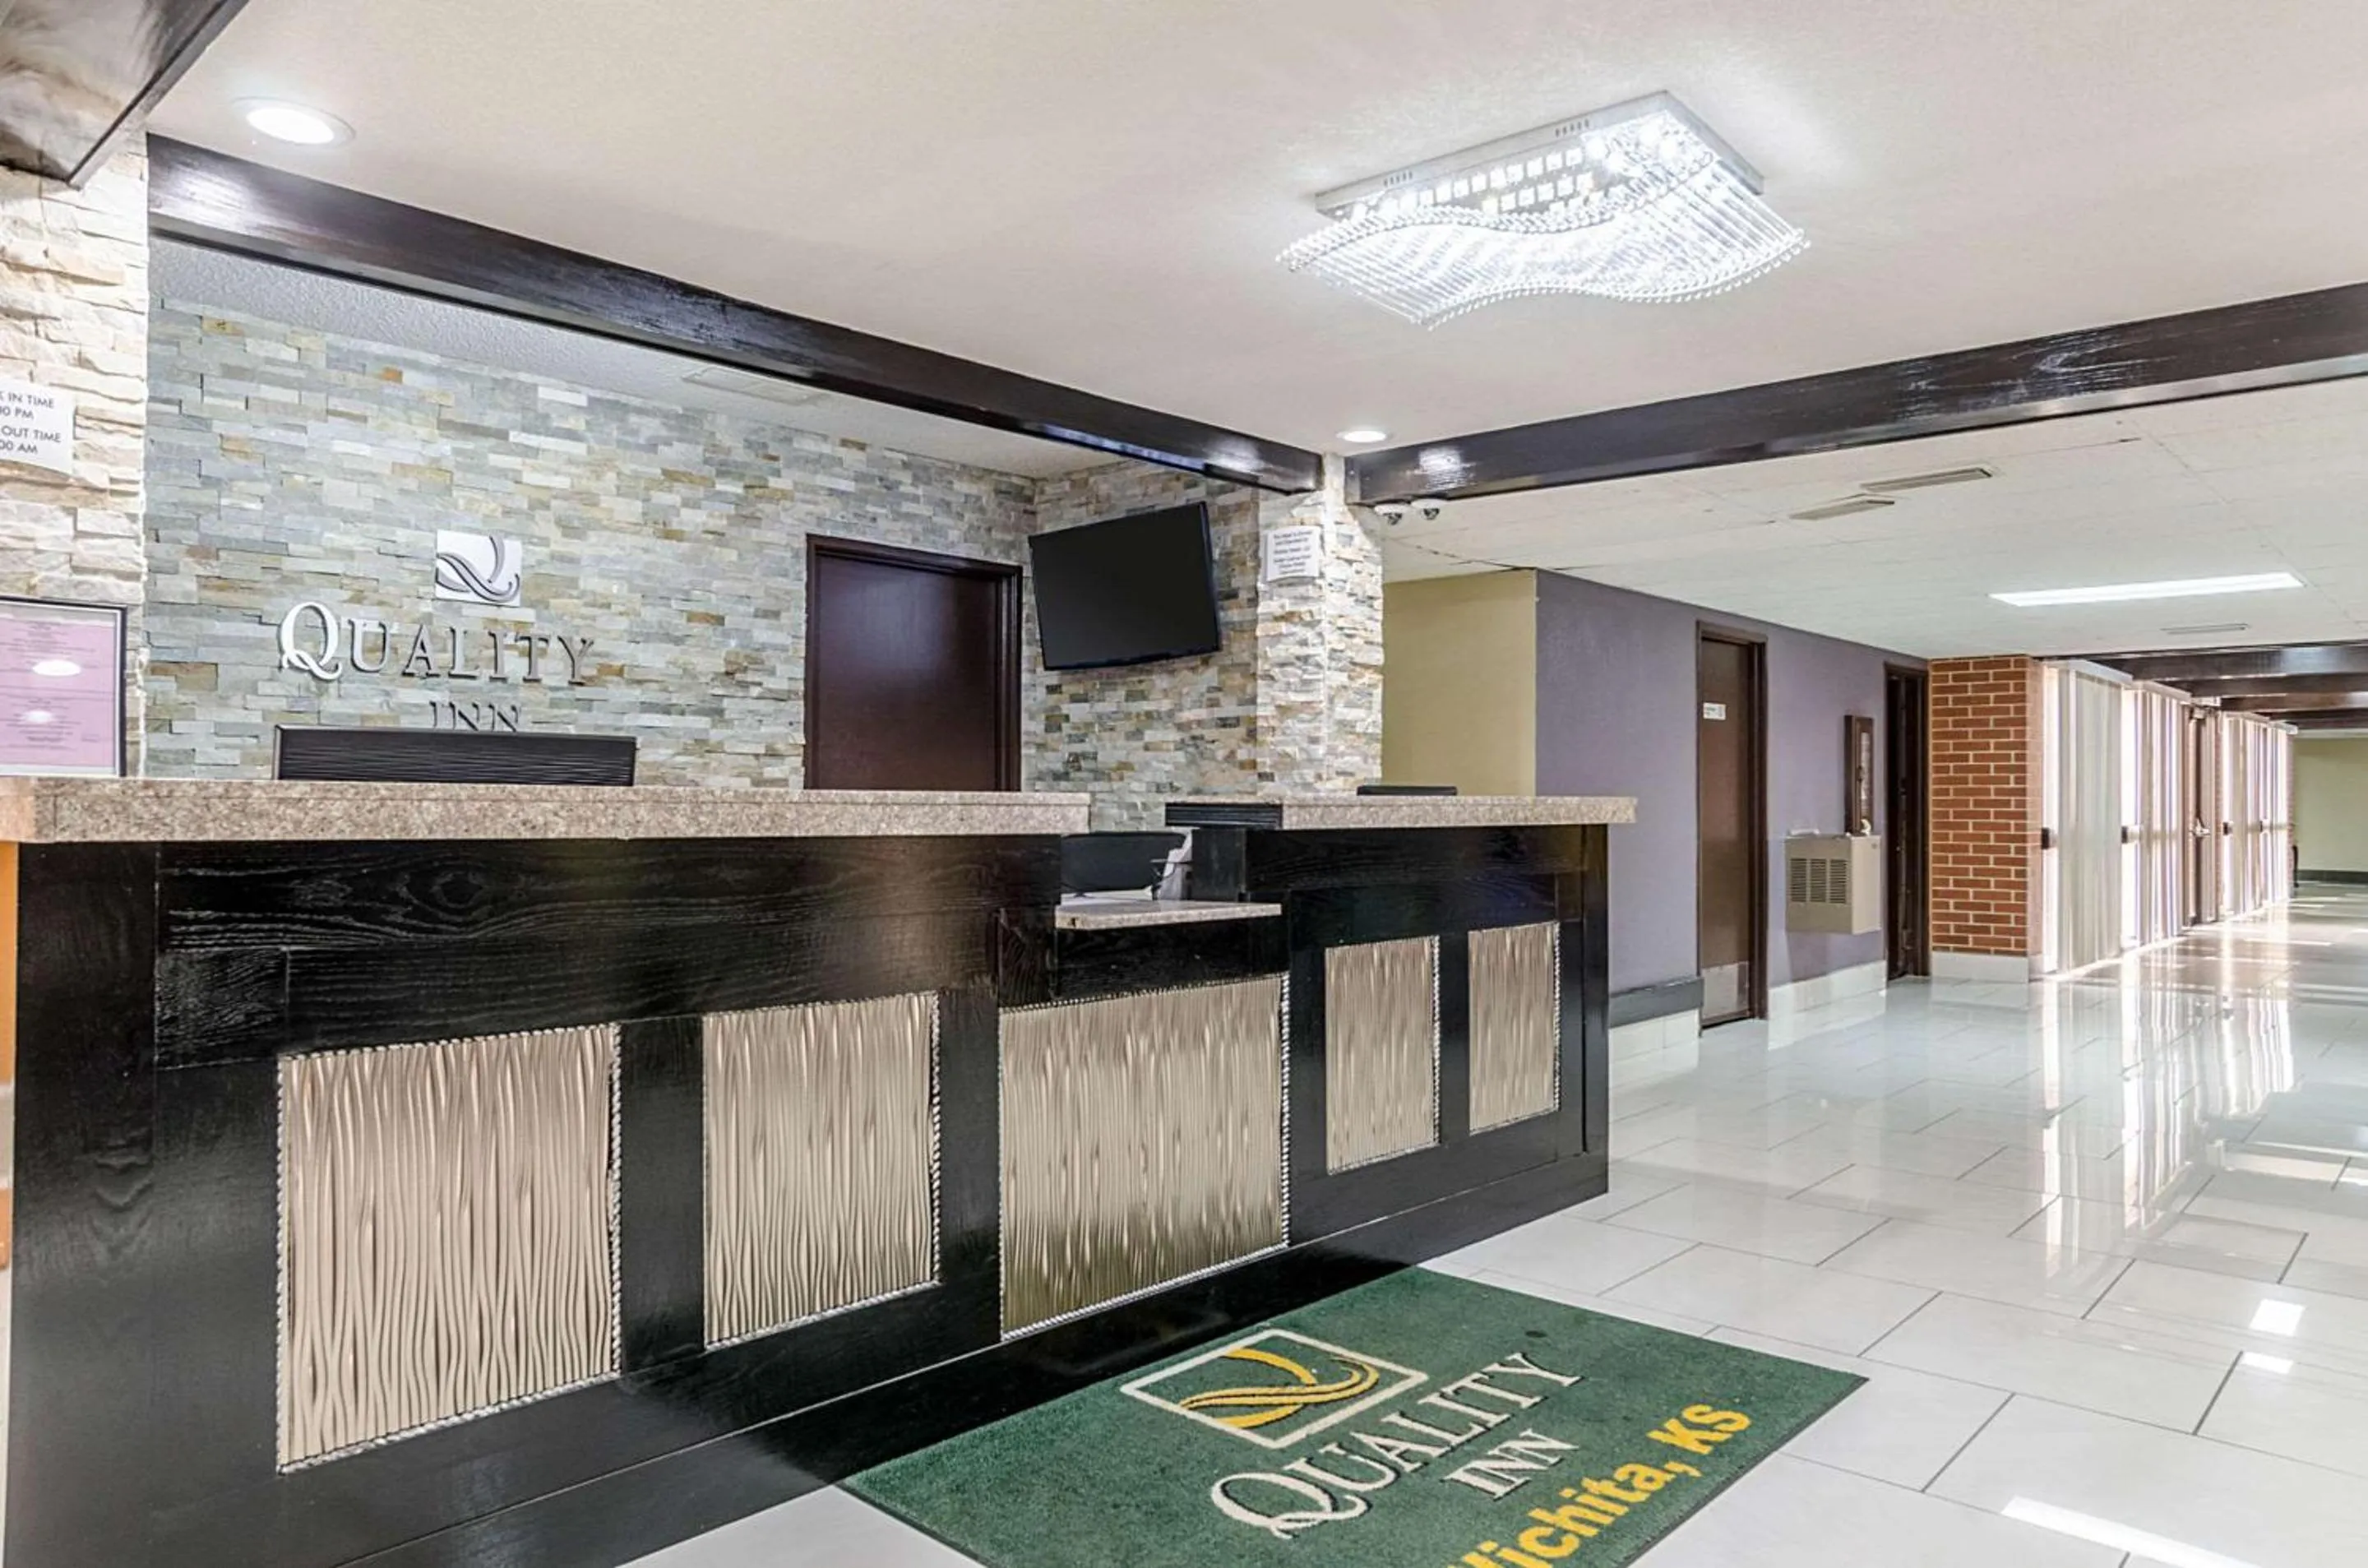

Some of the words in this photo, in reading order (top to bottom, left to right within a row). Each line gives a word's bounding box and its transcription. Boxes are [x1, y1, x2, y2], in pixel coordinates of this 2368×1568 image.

[8, 391, 22, 403] IN
[27, 395, 54, 409] TIME
[15, 406, 34, 419] PM
[1, 425, 29, 438] OUT
[34, 429, 62, 443] TIME
[17, 442, 38, 455] AM
[278, 600, 594, 686] QUALITY
[429, 701, 520, 732] INN
[1210, 1352, 1582, 1539] QUALITY
[1443, 1428, 1579, 1500] INN
[1448, 1462, 1702, 1568] ichita,
[1647, 1404, 1751, 1455] KS
